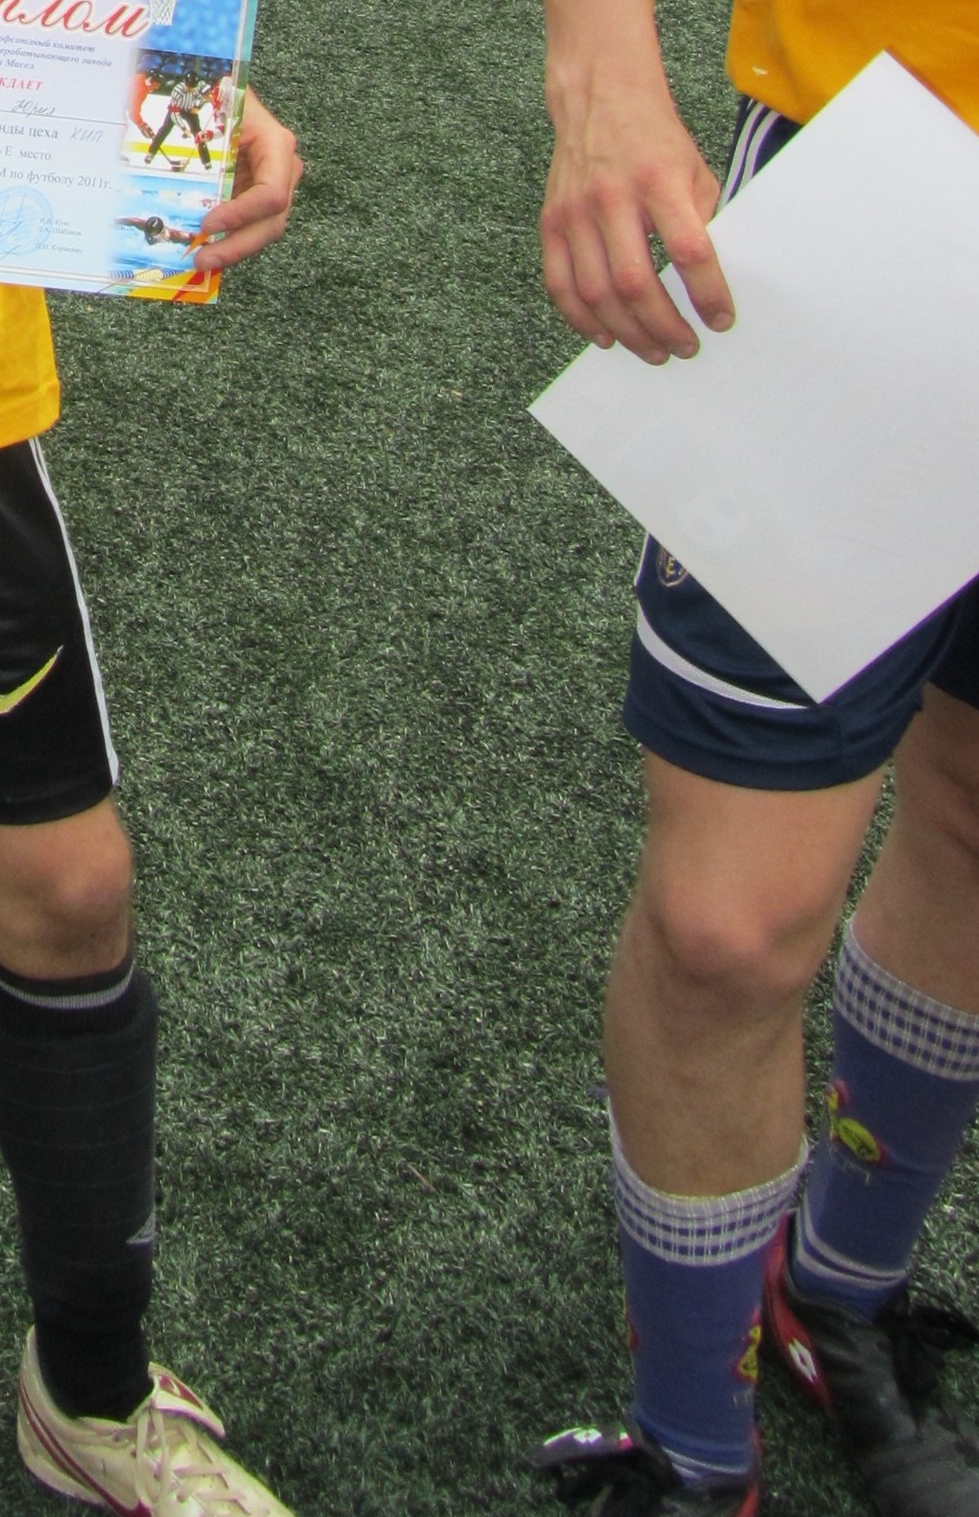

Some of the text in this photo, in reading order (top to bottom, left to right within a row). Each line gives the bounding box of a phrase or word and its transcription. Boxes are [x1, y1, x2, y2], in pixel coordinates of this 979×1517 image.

[6, 58, 35, 70] Масел
[28, 127, 58, 141] цеха
[18, 148, 52, 161] место
[10, 170, 24, 180] по
[26, 171, 76, 187] футболу
